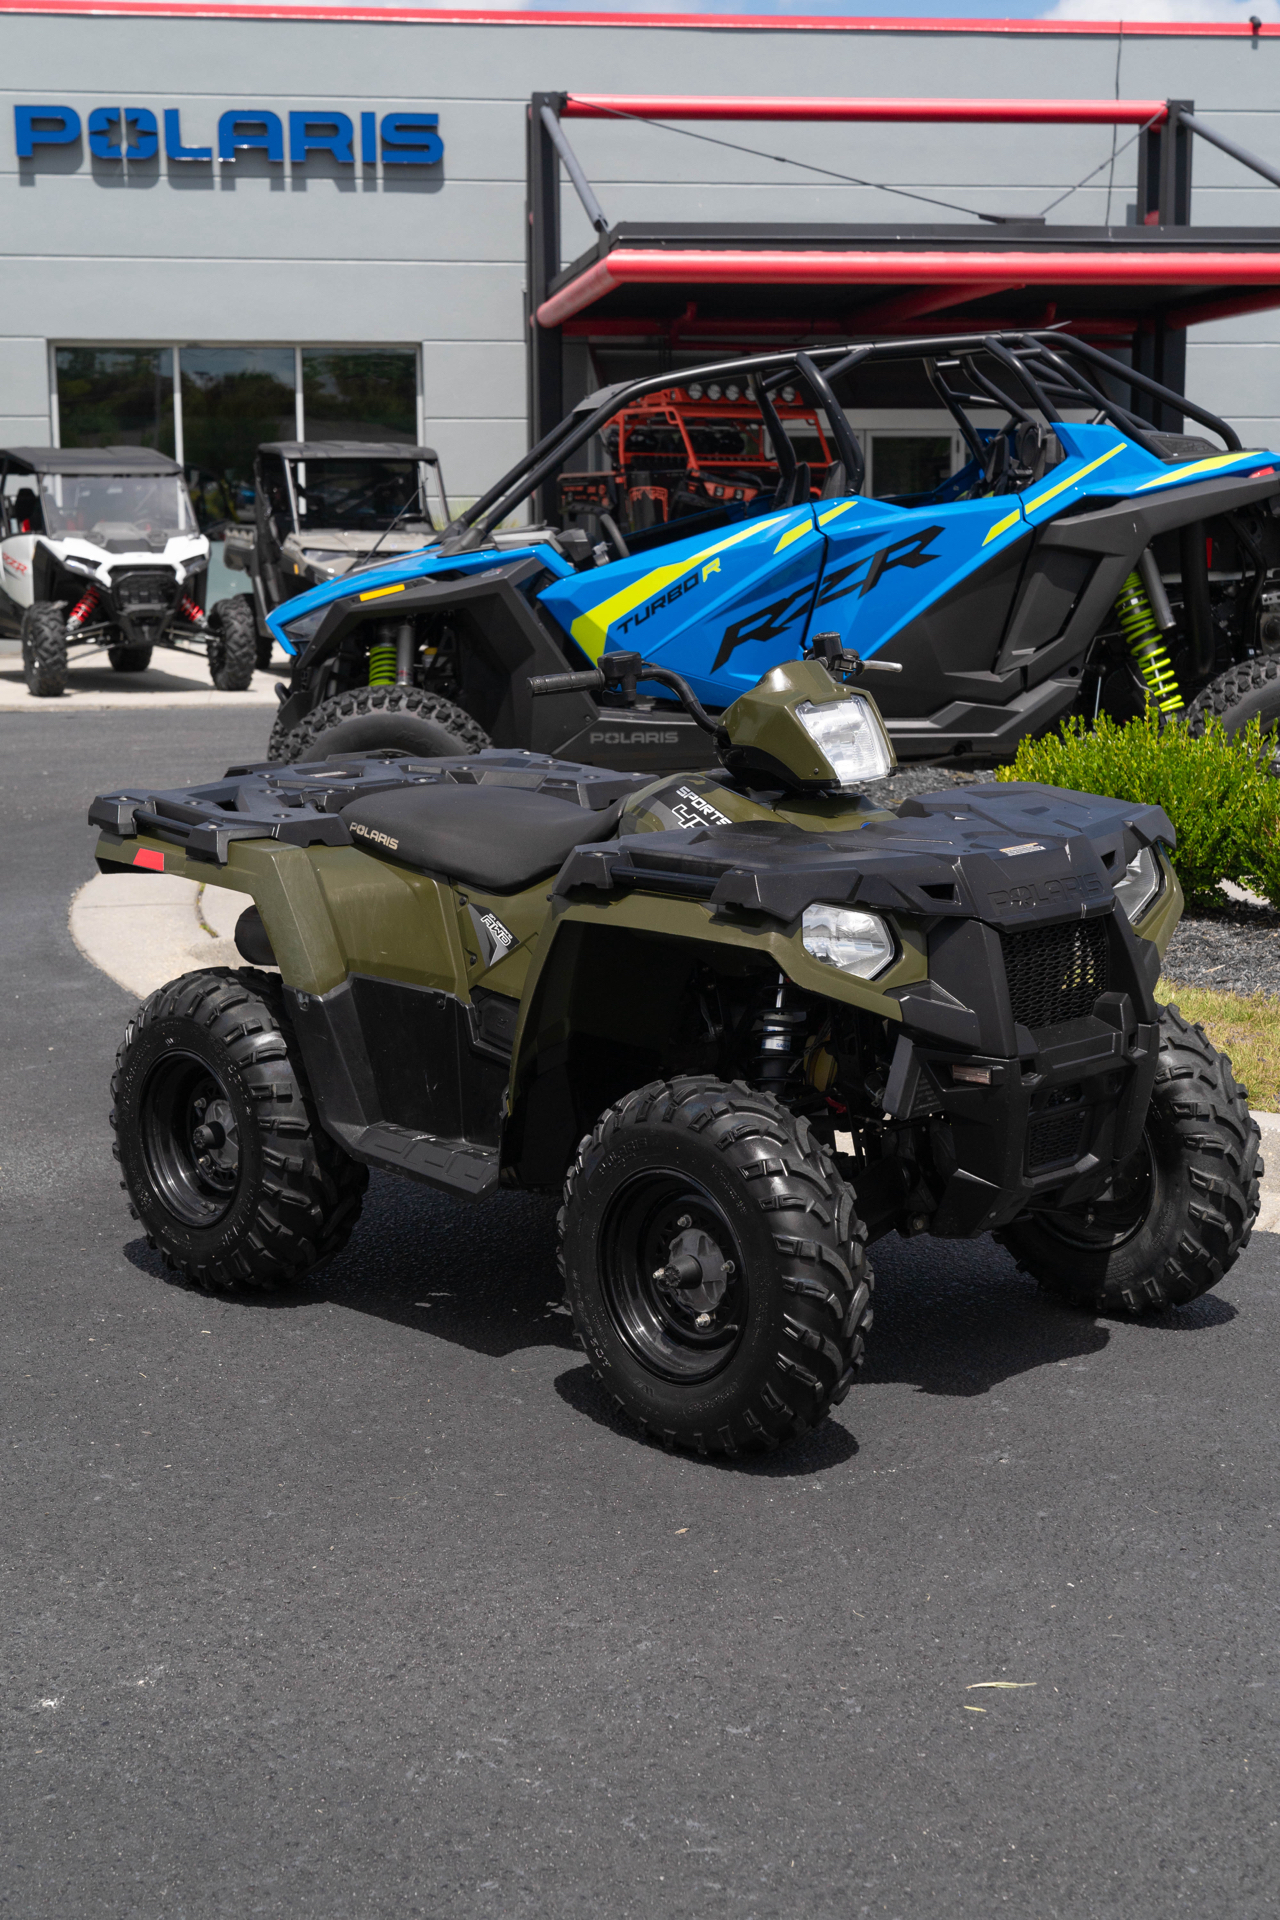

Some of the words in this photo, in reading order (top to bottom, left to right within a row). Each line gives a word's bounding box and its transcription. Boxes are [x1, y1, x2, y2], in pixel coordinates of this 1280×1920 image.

[14, 105, 444, 163] POLARIS
[617, 572, 700, 635] TURBO
[710, 525, 945, 674] RZR
[590, 730, 678, 744] POLARIS
[349, 821, 399, 850] POLARIS
[987, 872, 1105, 916] POLARIS
[480, 914, 512, 947] AWD
